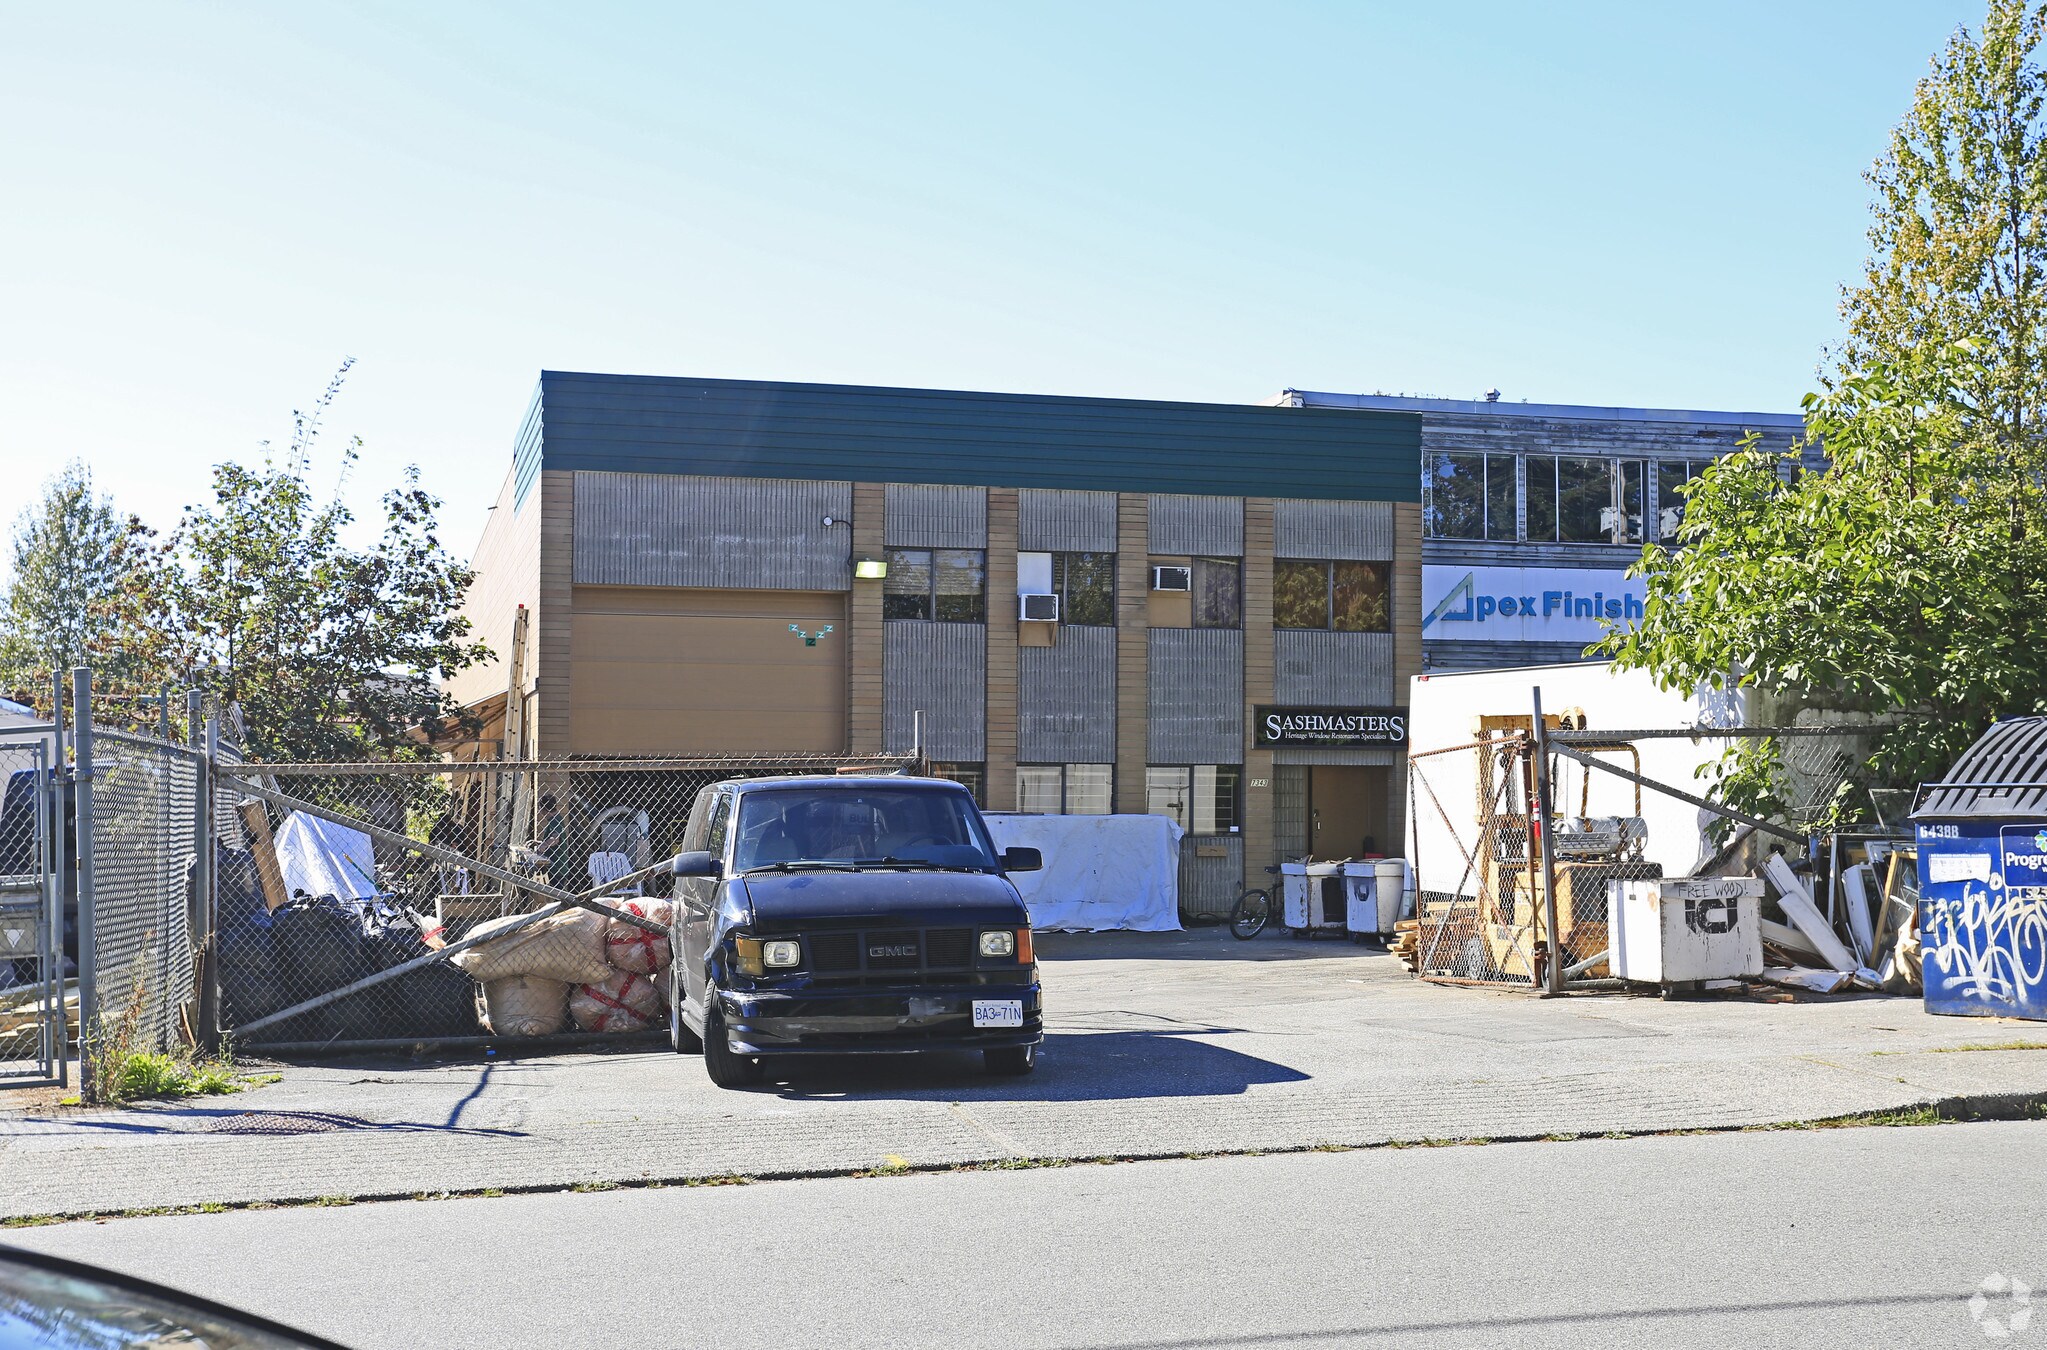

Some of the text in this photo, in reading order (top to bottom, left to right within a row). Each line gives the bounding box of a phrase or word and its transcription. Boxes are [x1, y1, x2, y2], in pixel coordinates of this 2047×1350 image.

[1266, 714, 1405, 741] SASHMASTERS
[1285, 732, 1308, 740] Heritage
[1678, 881, 1748, 898] FREE WOOD!
[870, 945, 917, 957] GMC
